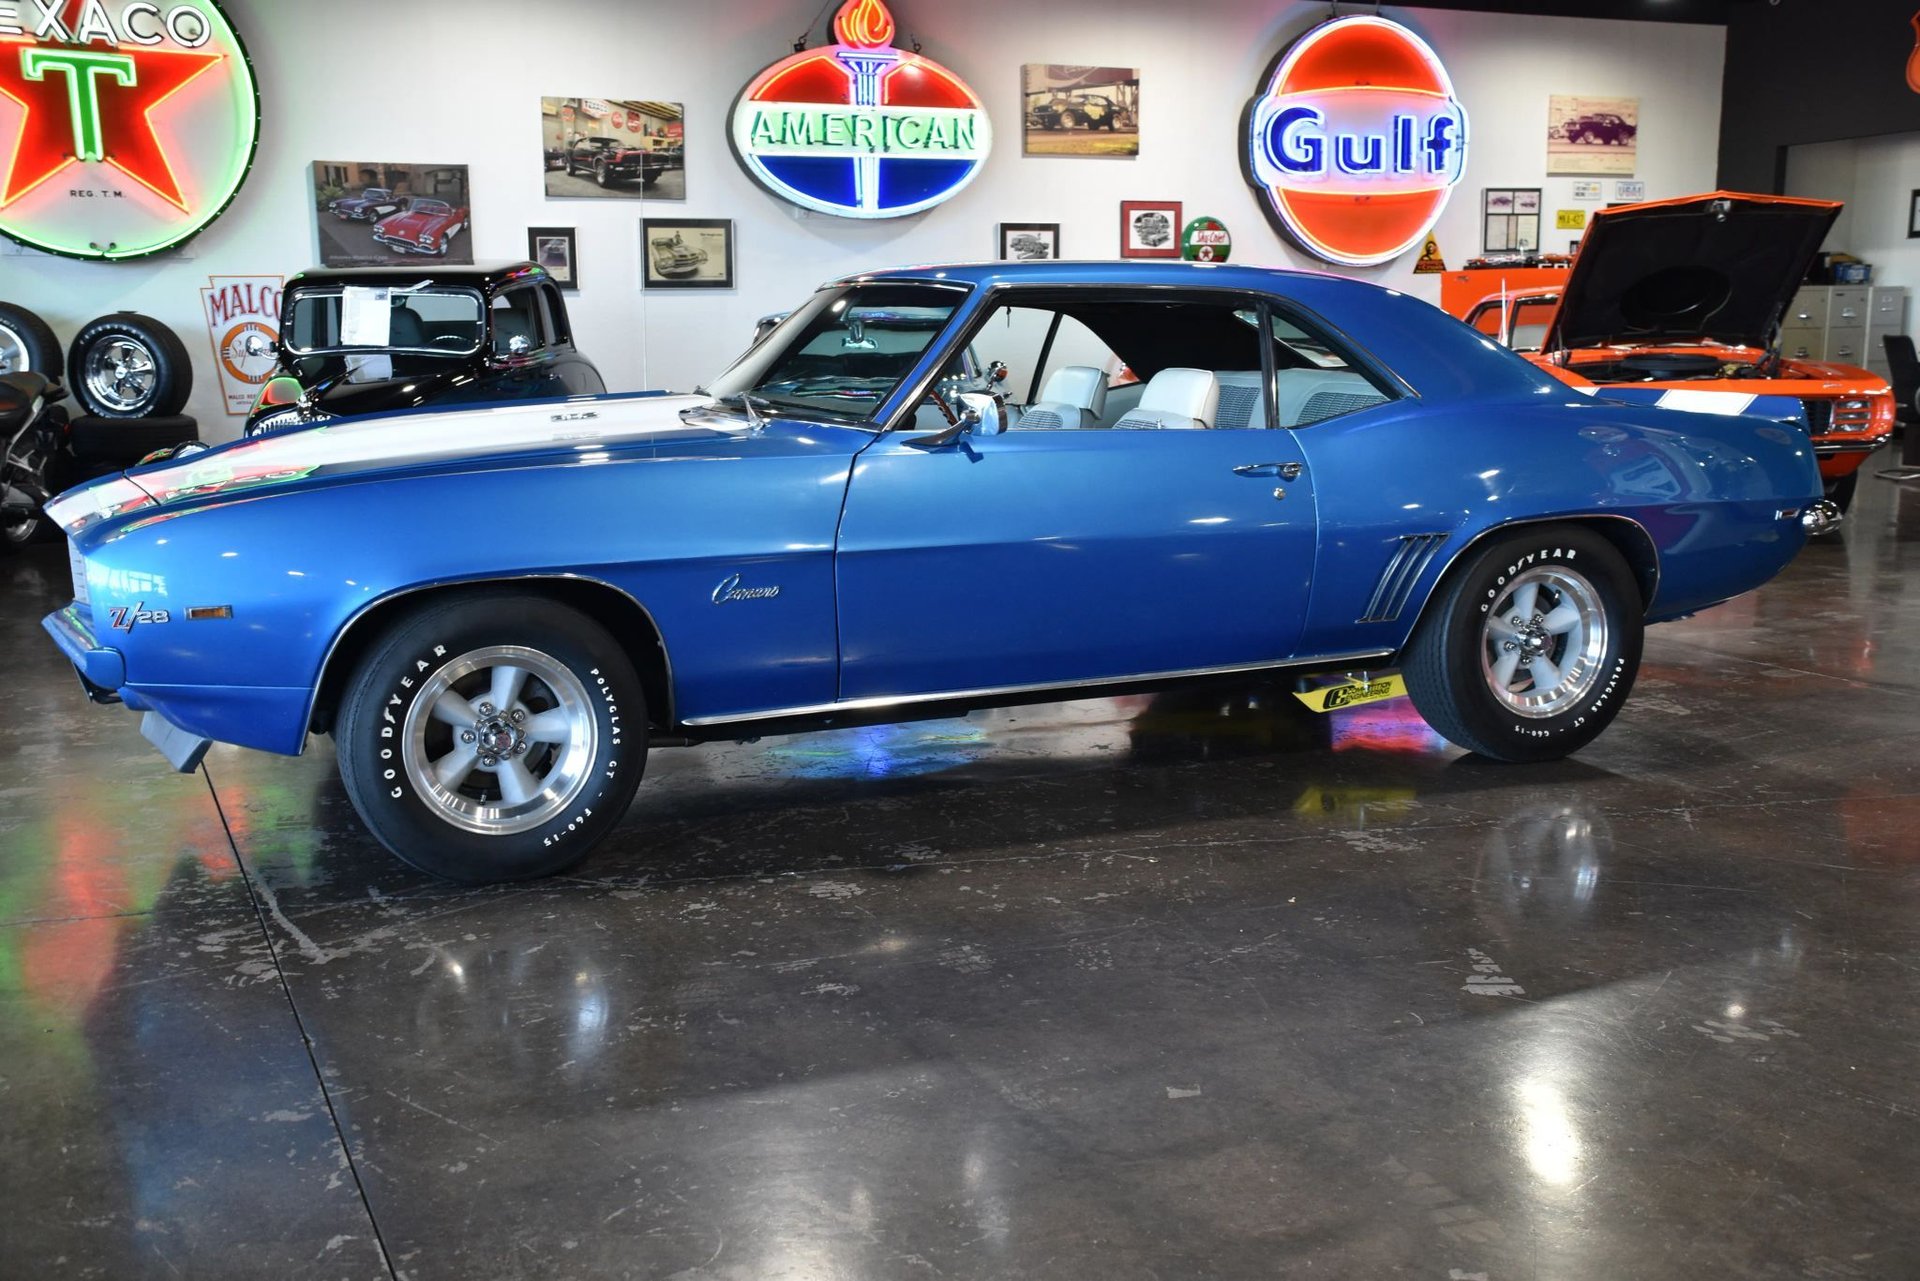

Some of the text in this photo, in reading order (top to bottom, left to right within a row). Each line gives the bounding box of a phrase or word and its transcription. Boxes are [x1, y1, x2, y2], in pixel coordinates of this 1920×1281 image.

[20, 47, 138, 162] T
[751, 109, 977, 151] AMERICAN
[1263, 105, 1457, 175] Gulf
[70, 189, 98, 198] REG.
[711, 573, 780, 605] Camaro
[1480, 548, 1577, 613] GOODYEAR
[109, 601, 170, 634] Z/28
[1348, 681, 1393, 695] COMTITION
[1590, 657, 1625, 713] POLYGLAS
[380, 644, 447, 799] GOODYEAR
[590, 667, 622, 745] POLYGLAS
[1573, 716, 1586, 728] GT
[605, 760, 618, 780] GT
[543, 807, 593, 847] F60-15
